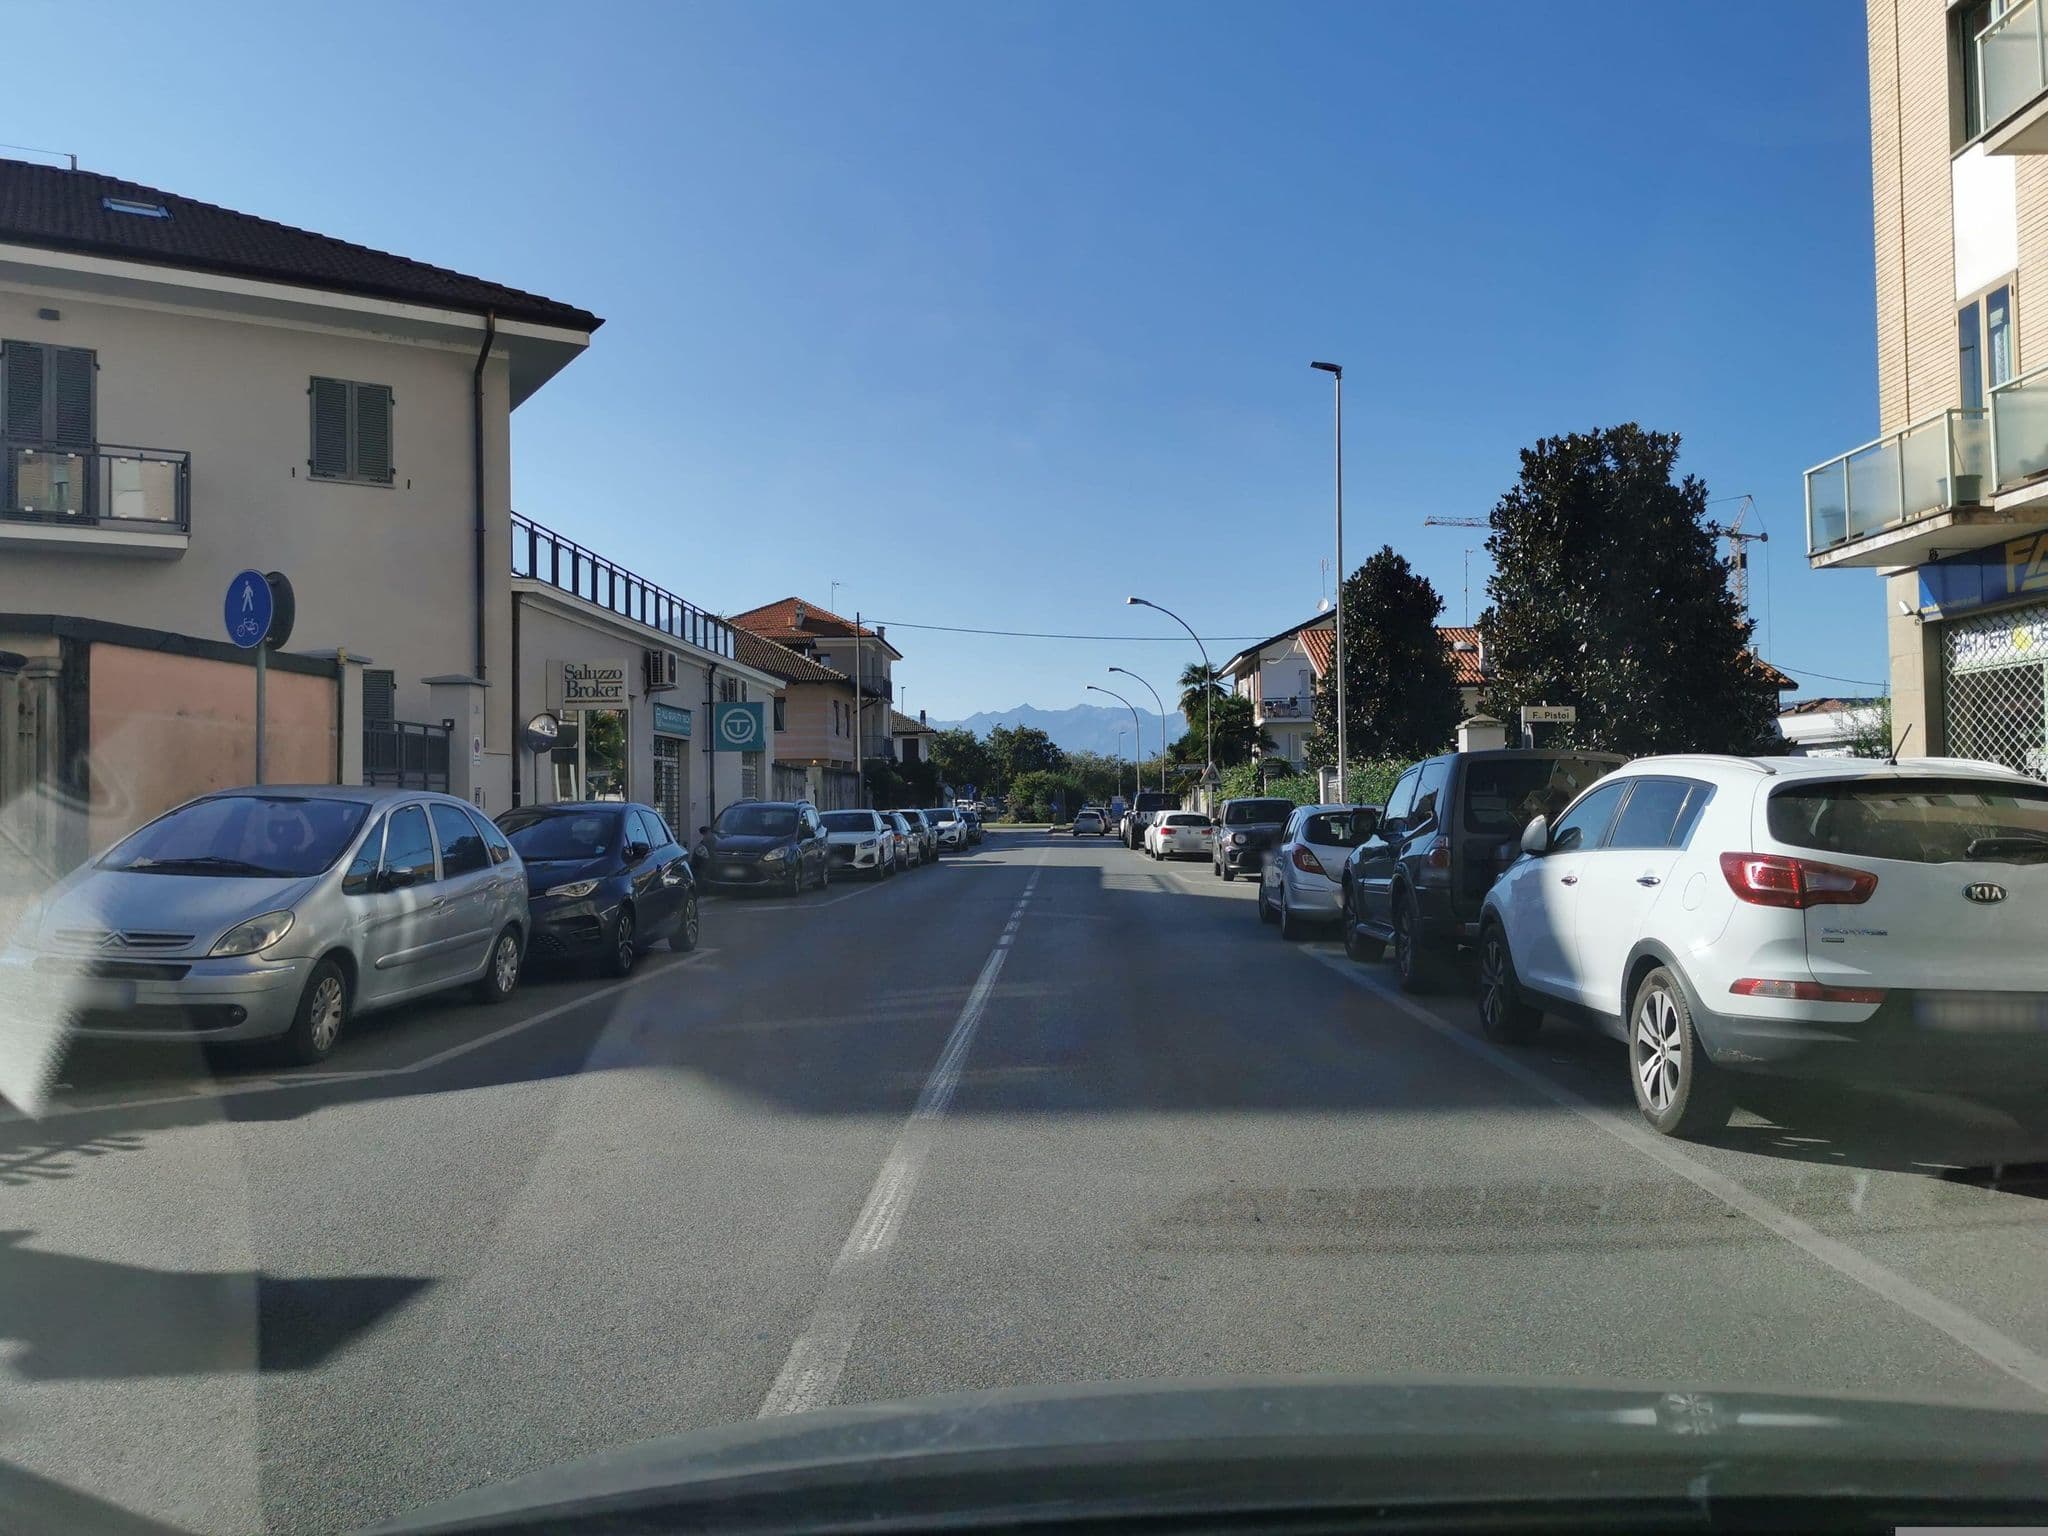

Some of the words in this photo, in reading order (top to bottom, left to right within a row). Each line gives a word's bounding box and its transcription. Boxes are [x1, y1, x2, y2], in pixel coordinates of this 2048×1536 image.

[564, 664, 623, 680] Saluzzo
[565, 680, 623, 698] Broker
[1970, 886, 2002, 900] KIA
